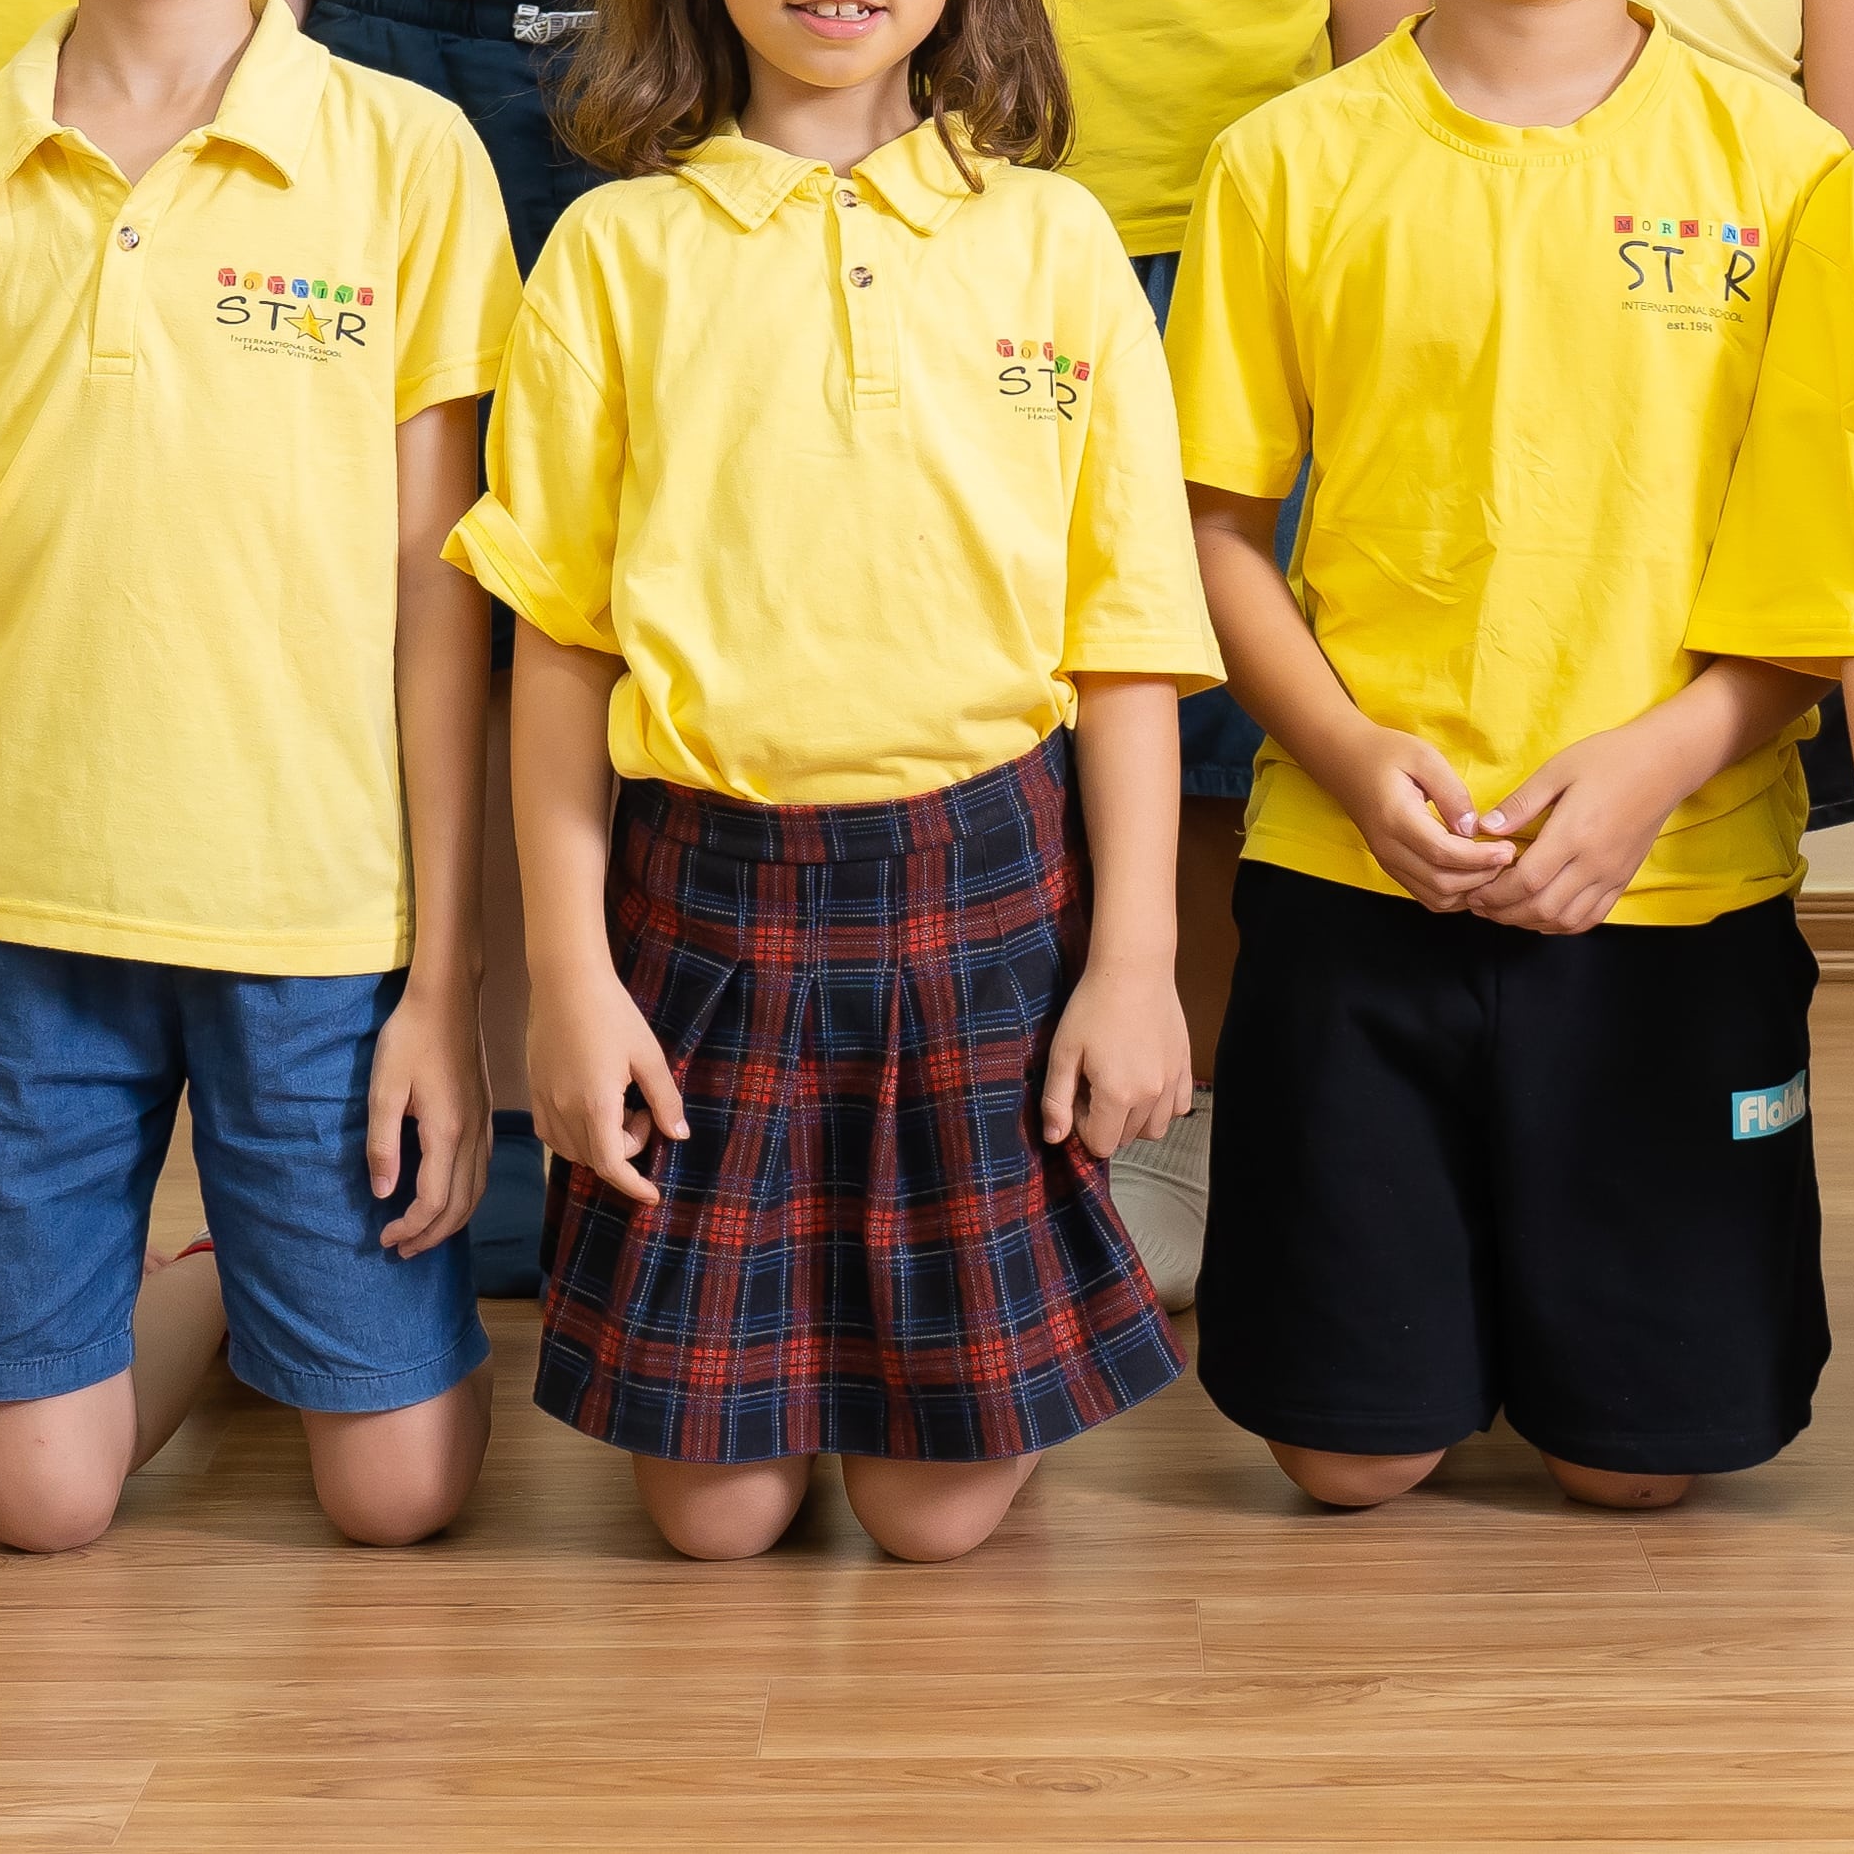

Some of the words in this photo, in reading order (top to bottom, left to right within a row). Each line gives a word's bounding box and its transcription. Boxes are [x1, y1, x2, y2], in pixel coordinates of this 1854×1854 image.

[1616, 218, 1758, 245] MORNING
[219, 270, 373, 306] MORNING
[1622, 301, 1707, 316] INTERNATIONAL
